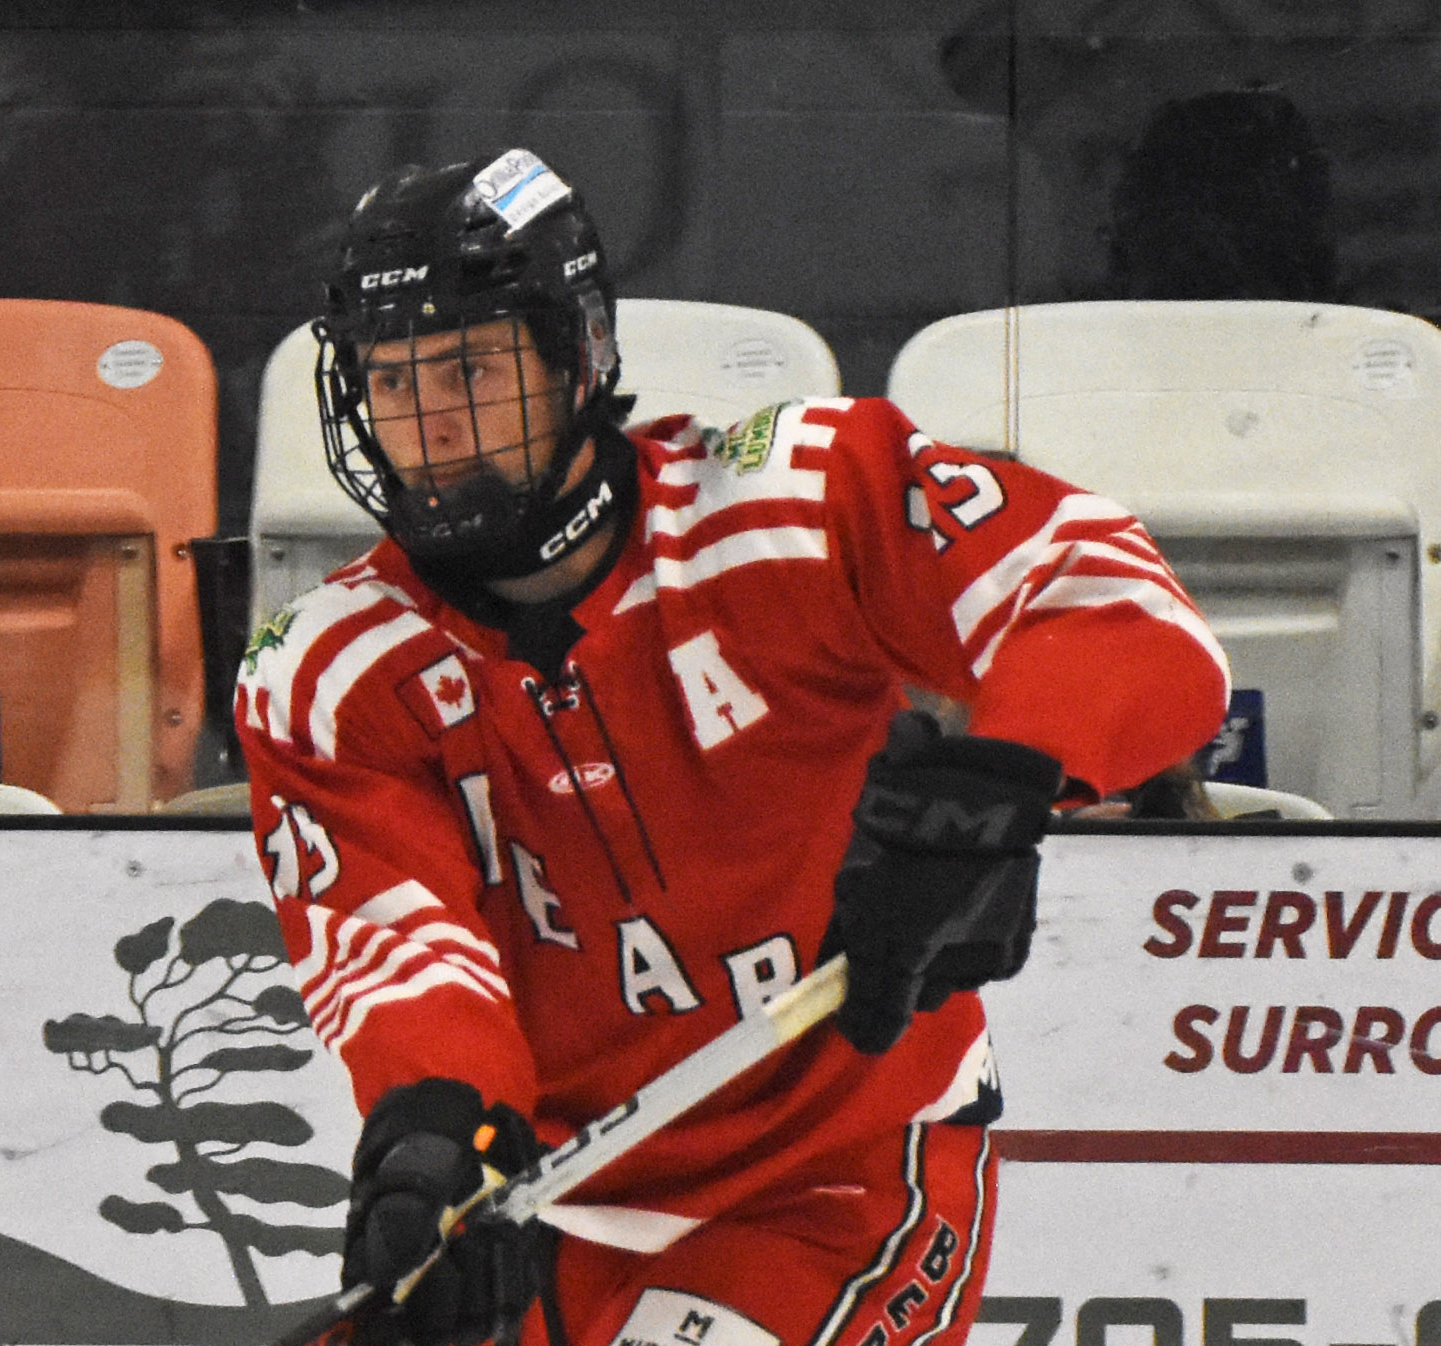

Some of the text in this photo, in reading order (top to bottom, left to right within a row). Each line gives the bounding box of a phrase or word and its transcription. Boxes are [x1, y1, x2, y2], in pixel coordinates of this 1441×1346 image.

[360, 264, 429, 289] CCM
[539, 480, 613, 560] CCM
[667, 630, 771, 752] A
[678, 1308, 715, 1340] M
